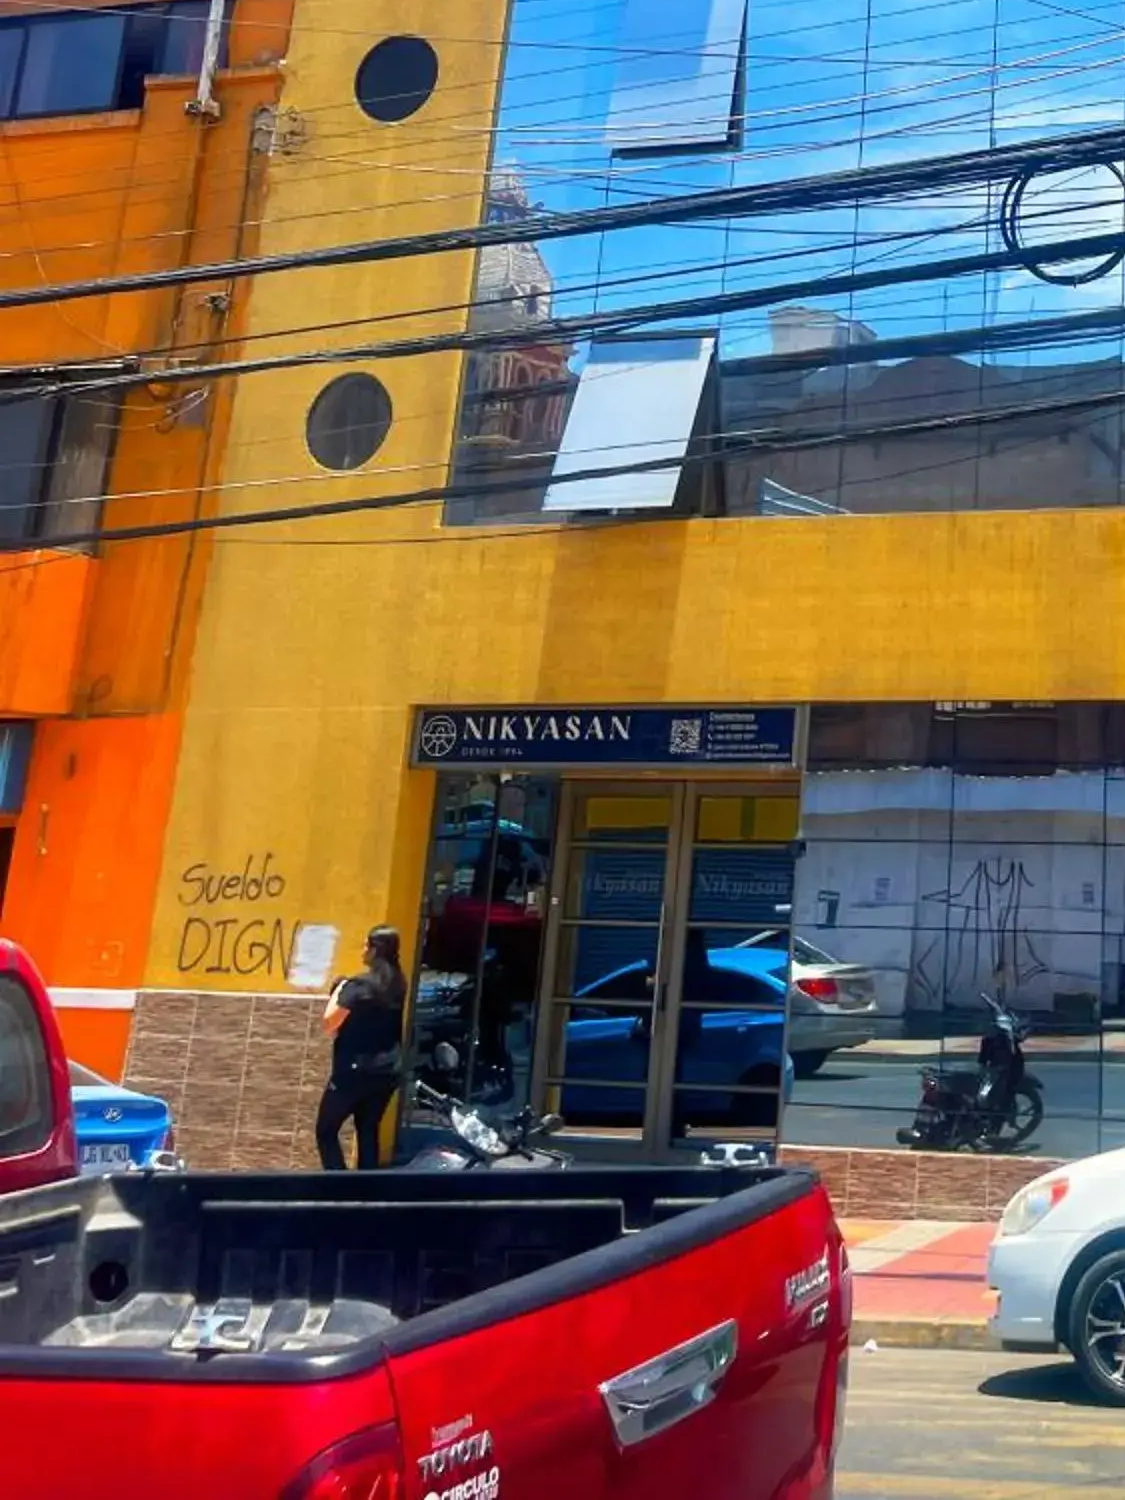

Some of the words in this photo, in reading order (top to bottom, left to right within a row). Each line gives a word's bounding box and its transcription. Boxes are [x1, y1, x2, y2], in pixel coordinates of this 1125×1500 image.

[461, 714, 632, 741] NIKYASAN
[177, 852, 286, 906] Sueldo
[416, 1429, 493, 1483] TOYOTA
